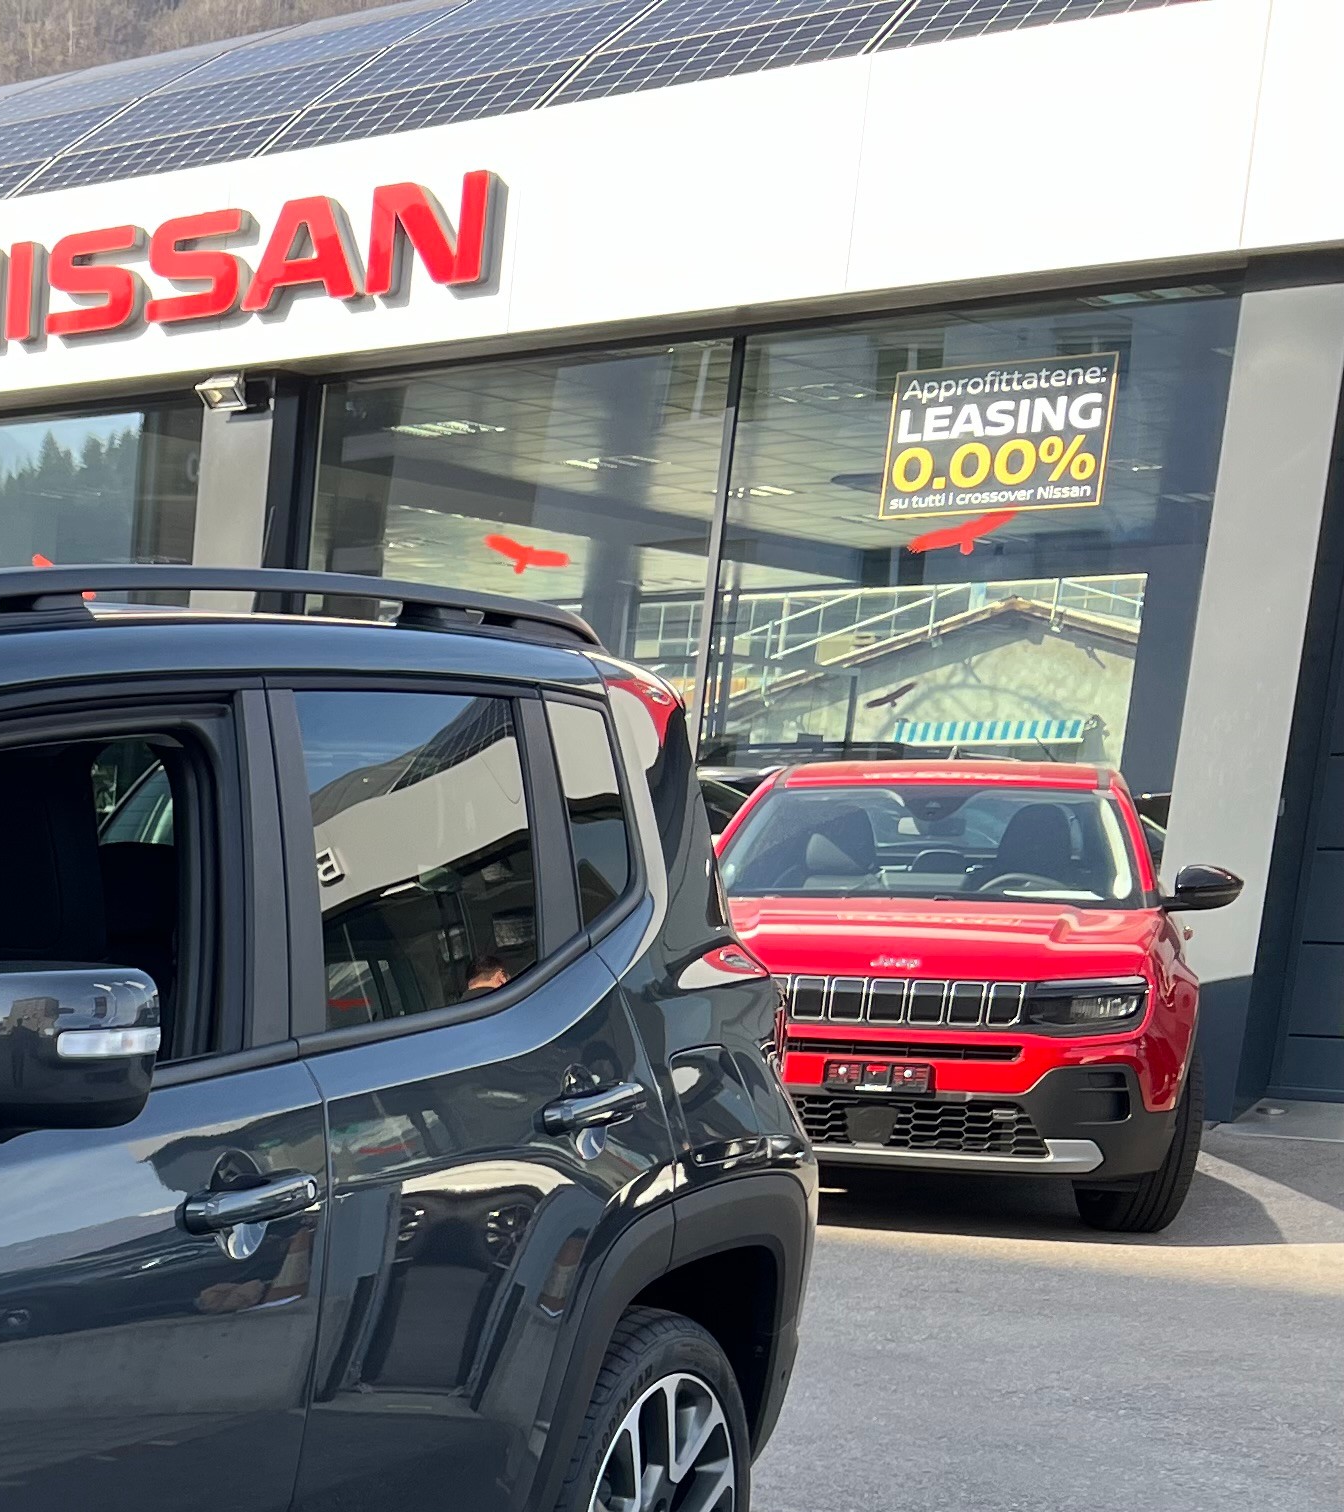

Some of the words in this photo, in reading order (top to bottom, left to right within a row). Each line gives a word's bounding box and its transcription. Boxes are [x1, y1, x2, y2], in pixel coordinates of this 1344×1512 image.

[902, 366, 1108, 404] Approfittatene:
[897, 392, 1104, 443] LEASING
[891, 434, 1096, 492] 0.00%
[889, 498, 908, 510] su
[911, 492, 946, 508] tutti
[956, 487, 1034, 505] crossover
[1036, 484, 1091, 500] Nissan
